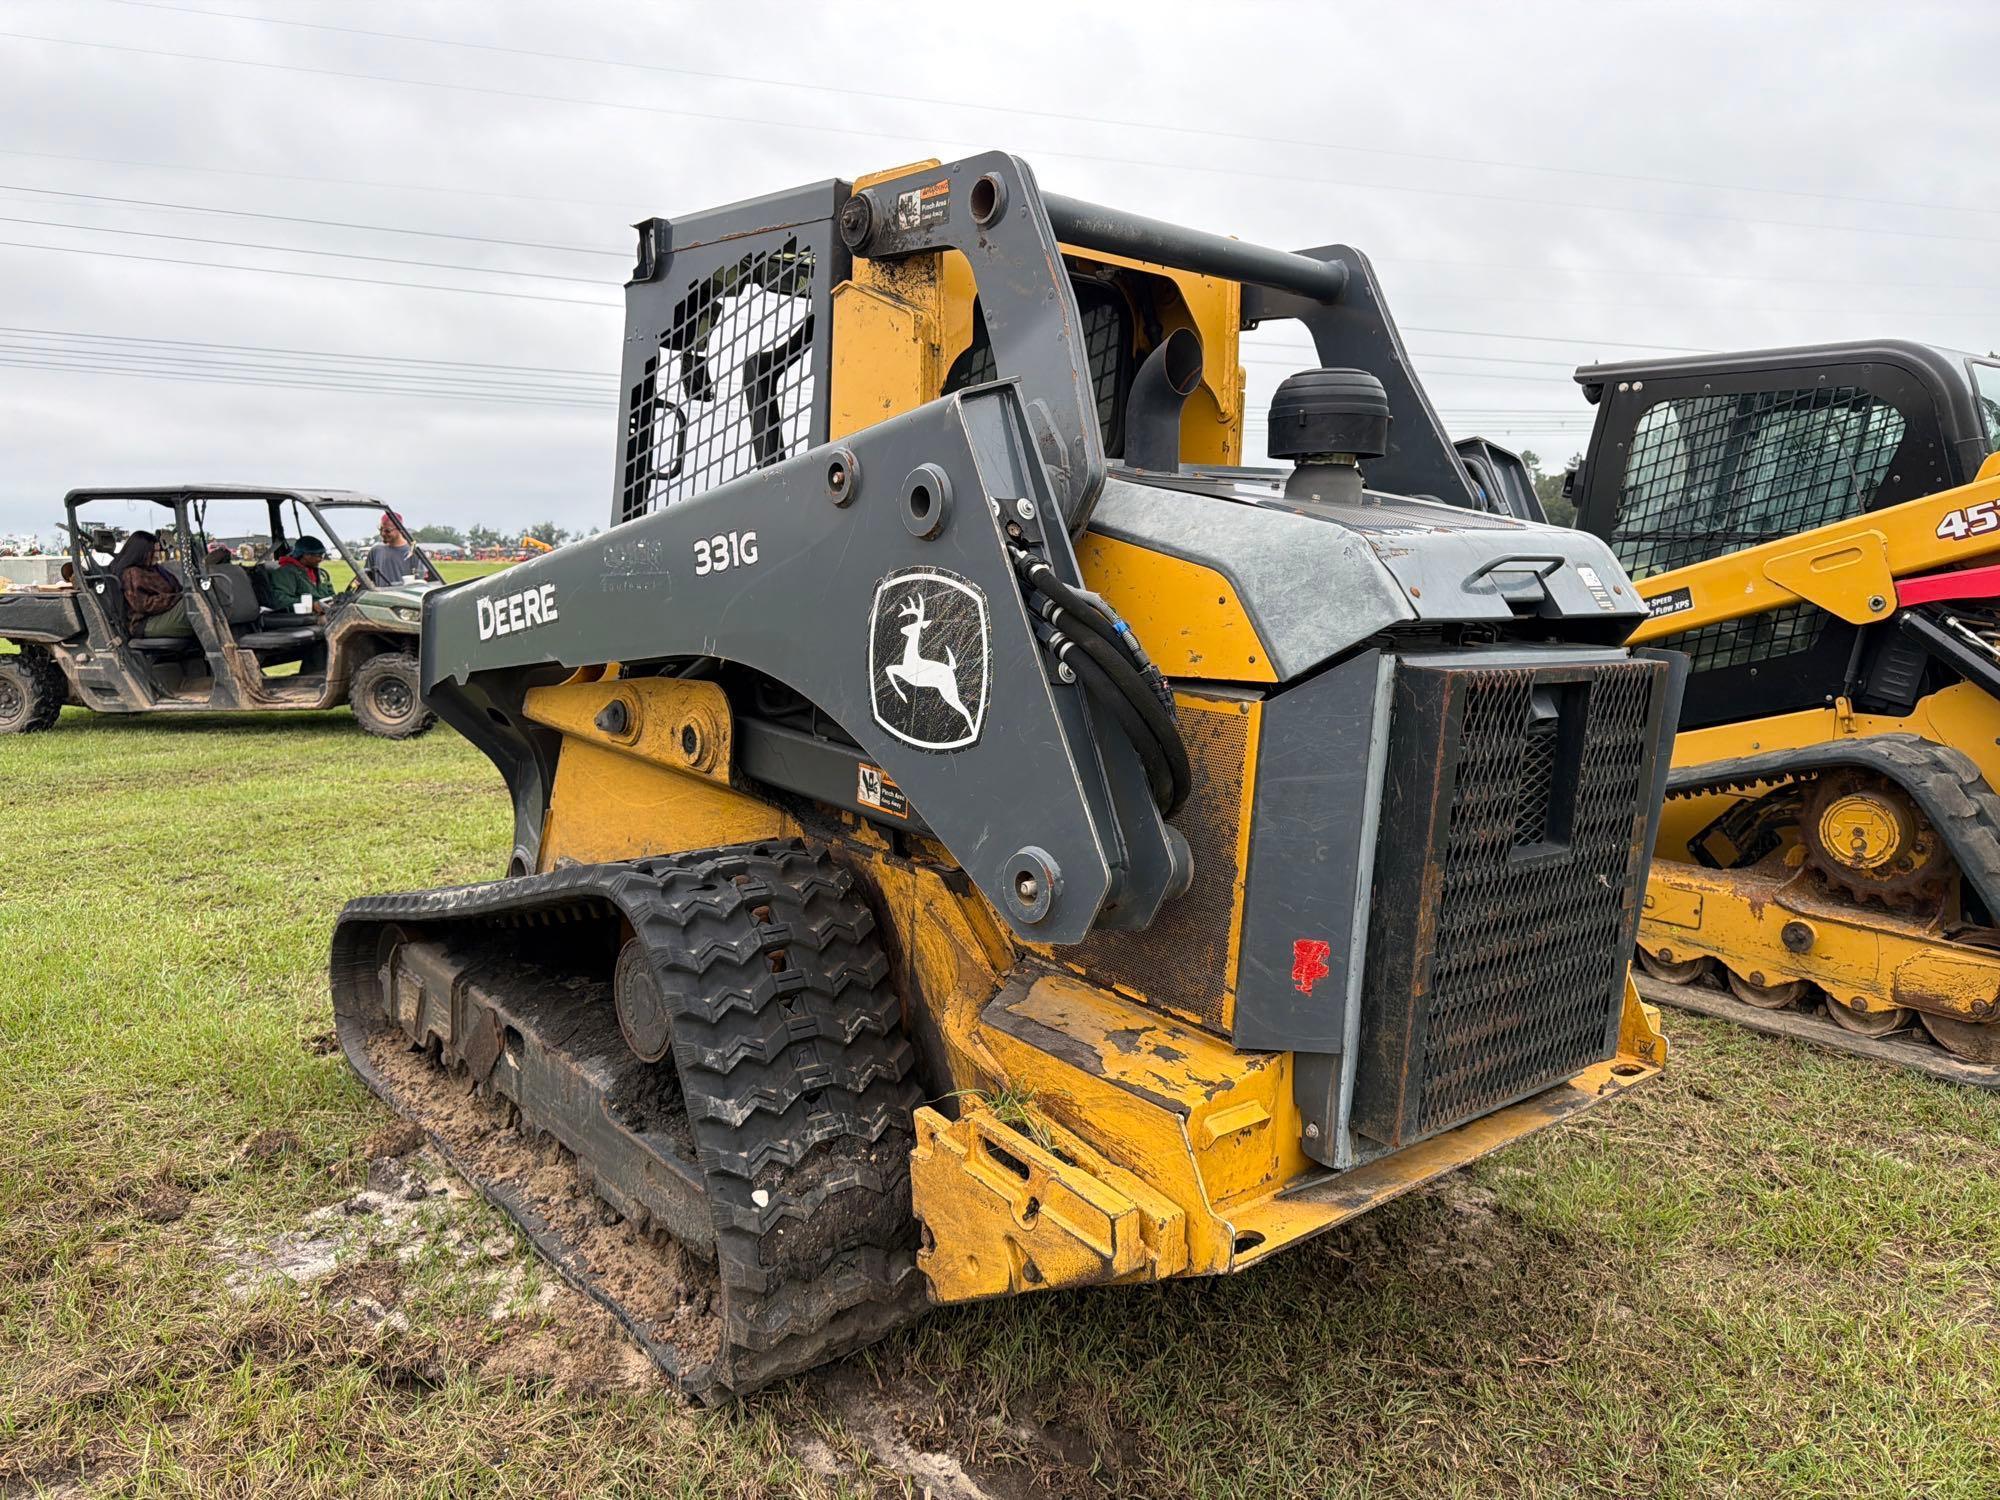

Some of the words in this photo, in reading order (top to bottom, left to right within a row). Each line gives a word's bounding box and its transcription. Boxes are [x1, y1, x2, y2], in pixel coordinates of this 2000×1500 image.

[936, 200, 947, 208] Area
[1936, 499, 2000, 540] 45
[693, 530, 759, 576] 331G
[477, 583, 558, 641] DEERE
[1651, 595, 1673, 607] SPEED
[1655, 604, 1674, 616] FLOW
[1674, 599, 1690, 611] XPS
